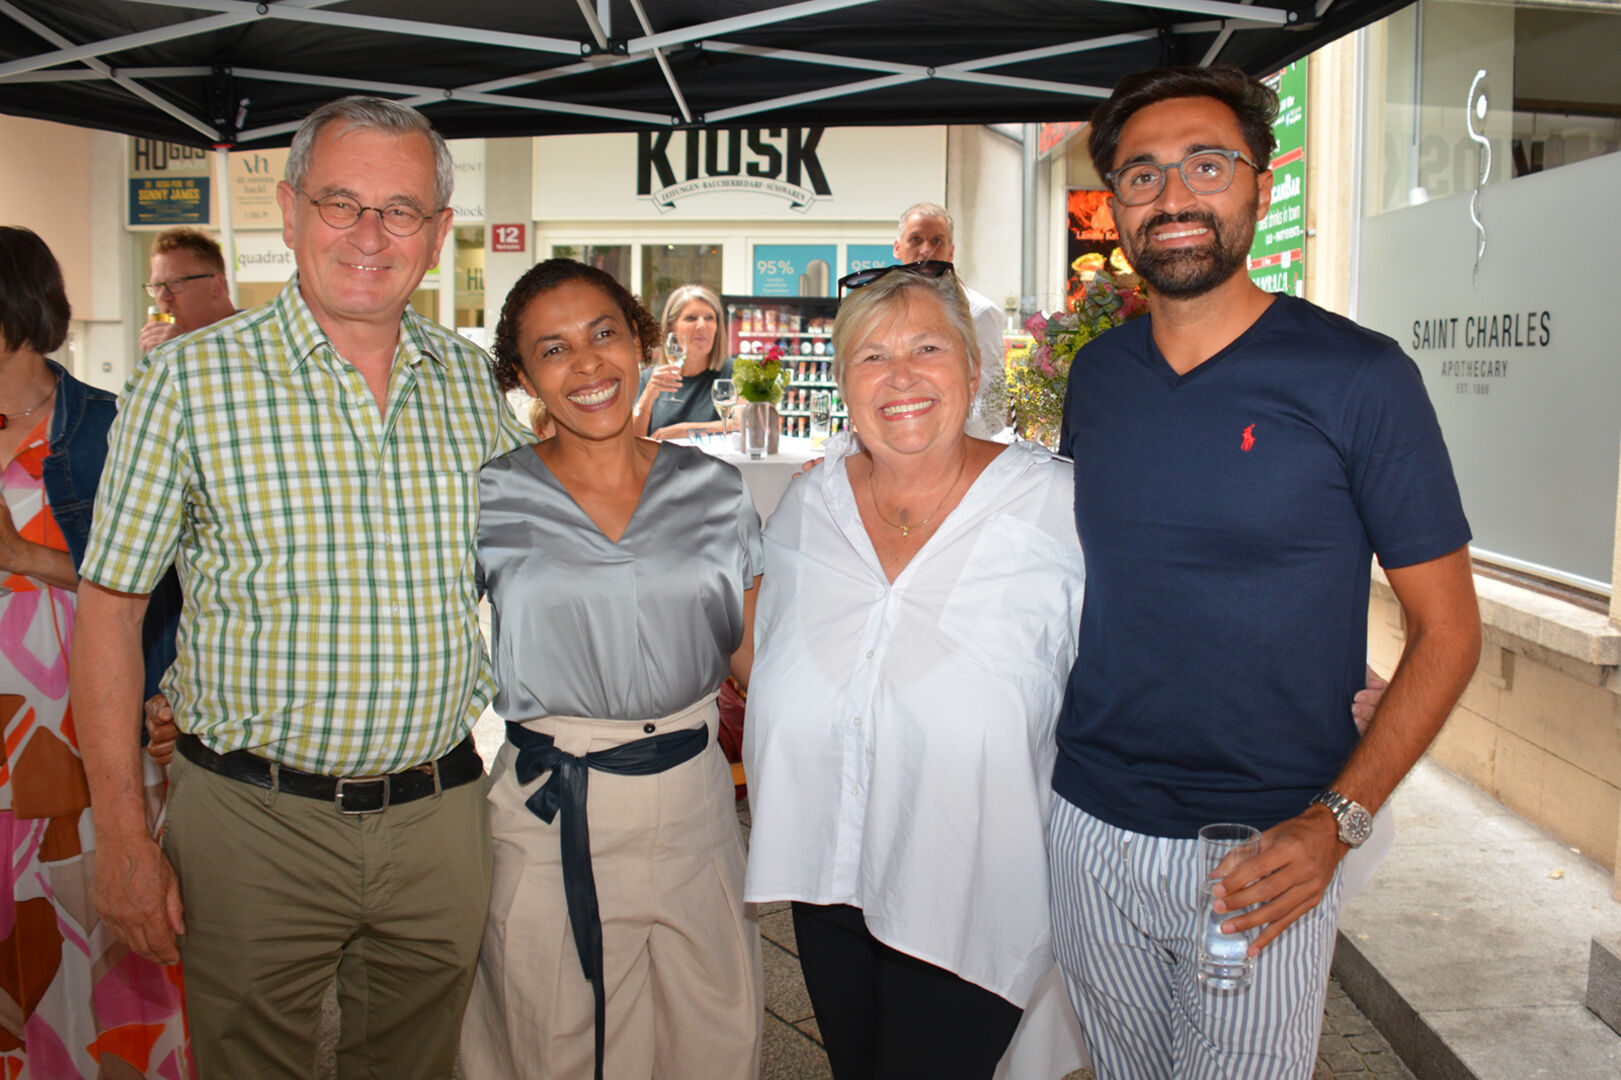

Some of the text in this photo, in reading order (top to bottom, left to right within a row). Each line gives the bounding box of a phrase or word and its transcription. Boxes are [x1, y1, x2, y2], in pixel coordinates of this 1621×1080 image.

[637, 127, 832, 195] KIOSK
[169, 188, 200, 201] JAMES
[496, 226, 520, 244] 12
[238, 251, 291, 266] quadrat
[757, 260, 795, 275] 95%
[1412, 310, 1551, 350] SAINT CHARLES
[1441, 360, 1508, 377] APOTHECARY
